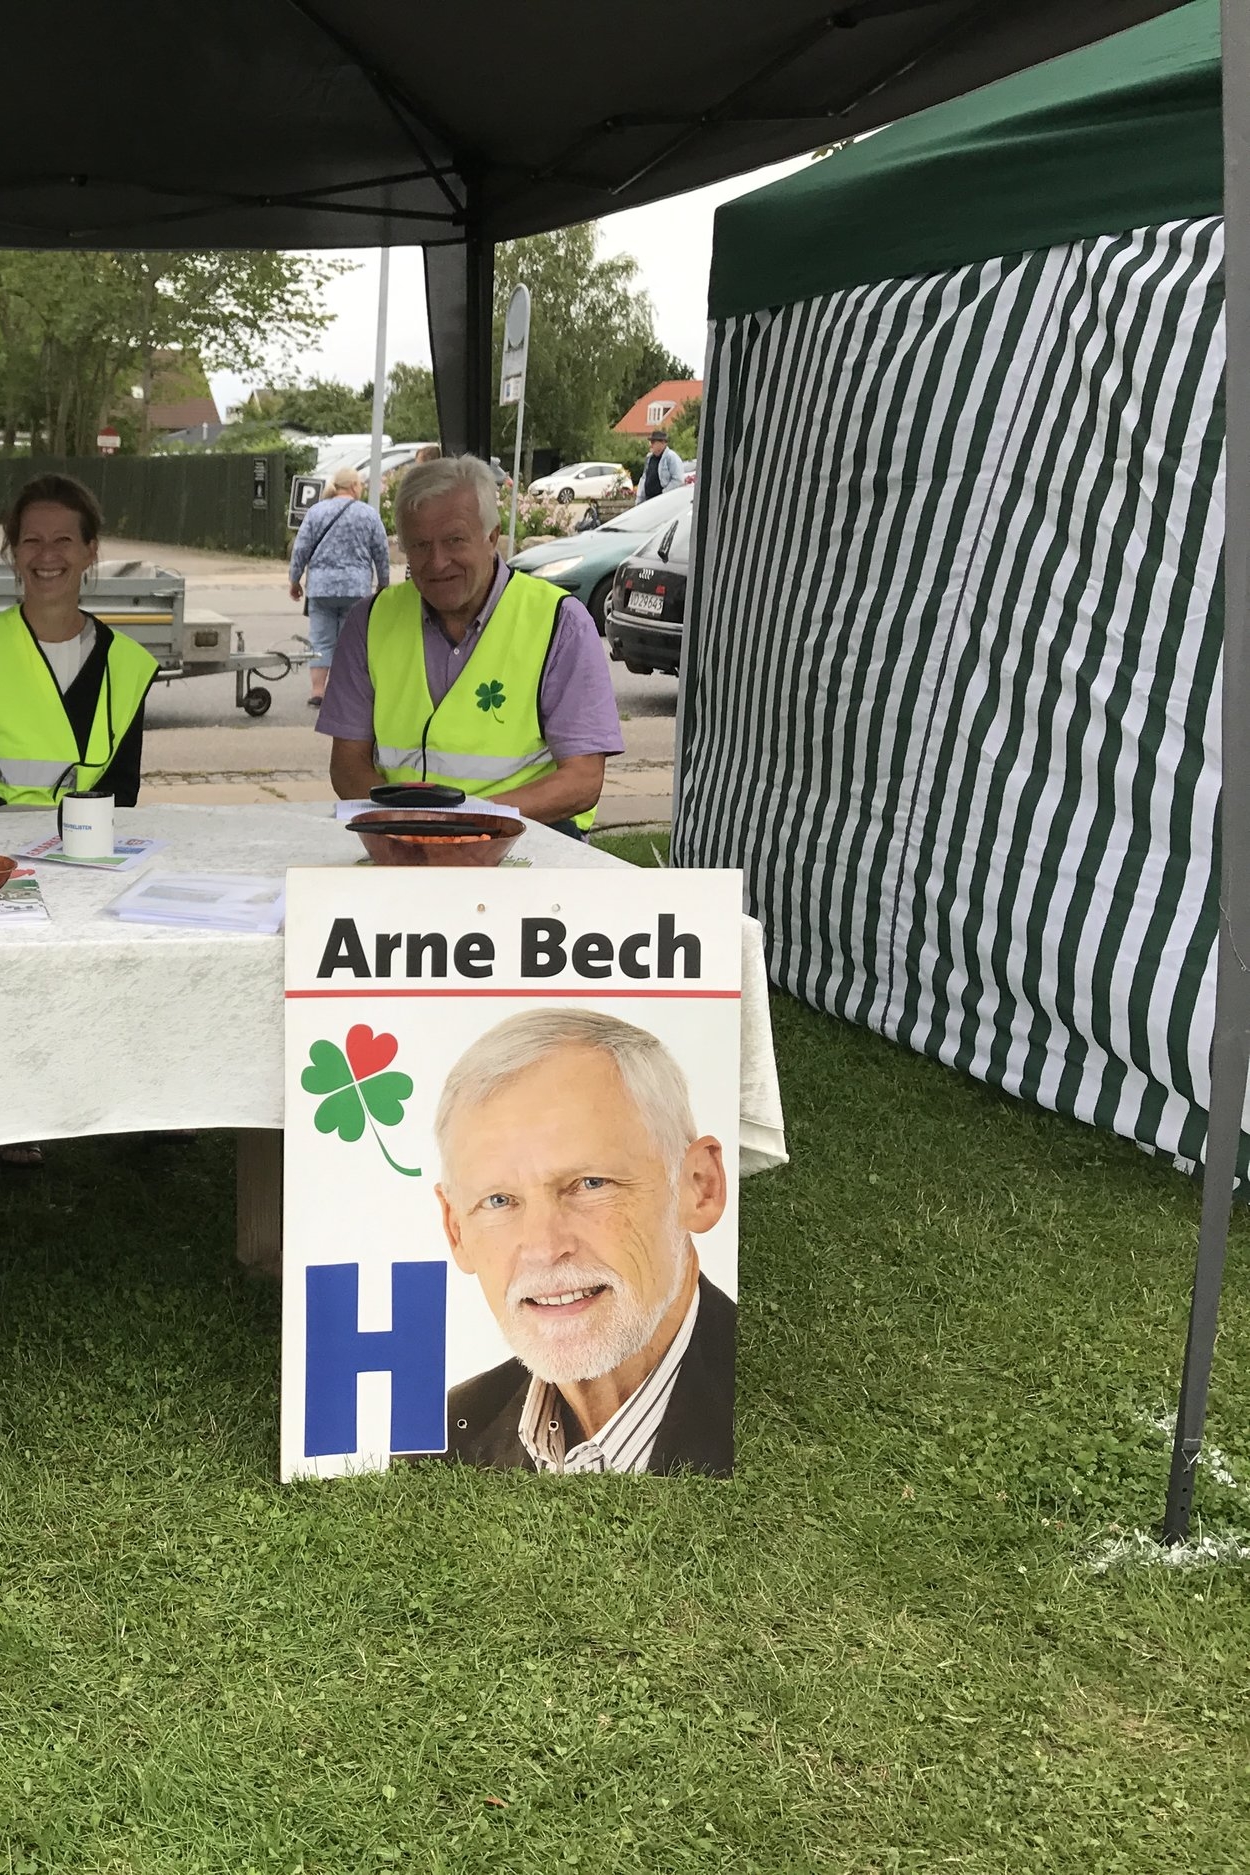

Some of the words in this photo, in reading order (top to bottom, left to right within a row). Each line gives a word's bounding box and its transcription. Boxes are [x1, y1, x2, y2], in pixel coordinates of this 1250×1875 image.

[301, 485, 317, 505] P
[316, 918, 496, 979] Arne
[520, 913, 702, 979] Bech
[304, 1261, 448, 1458] H
